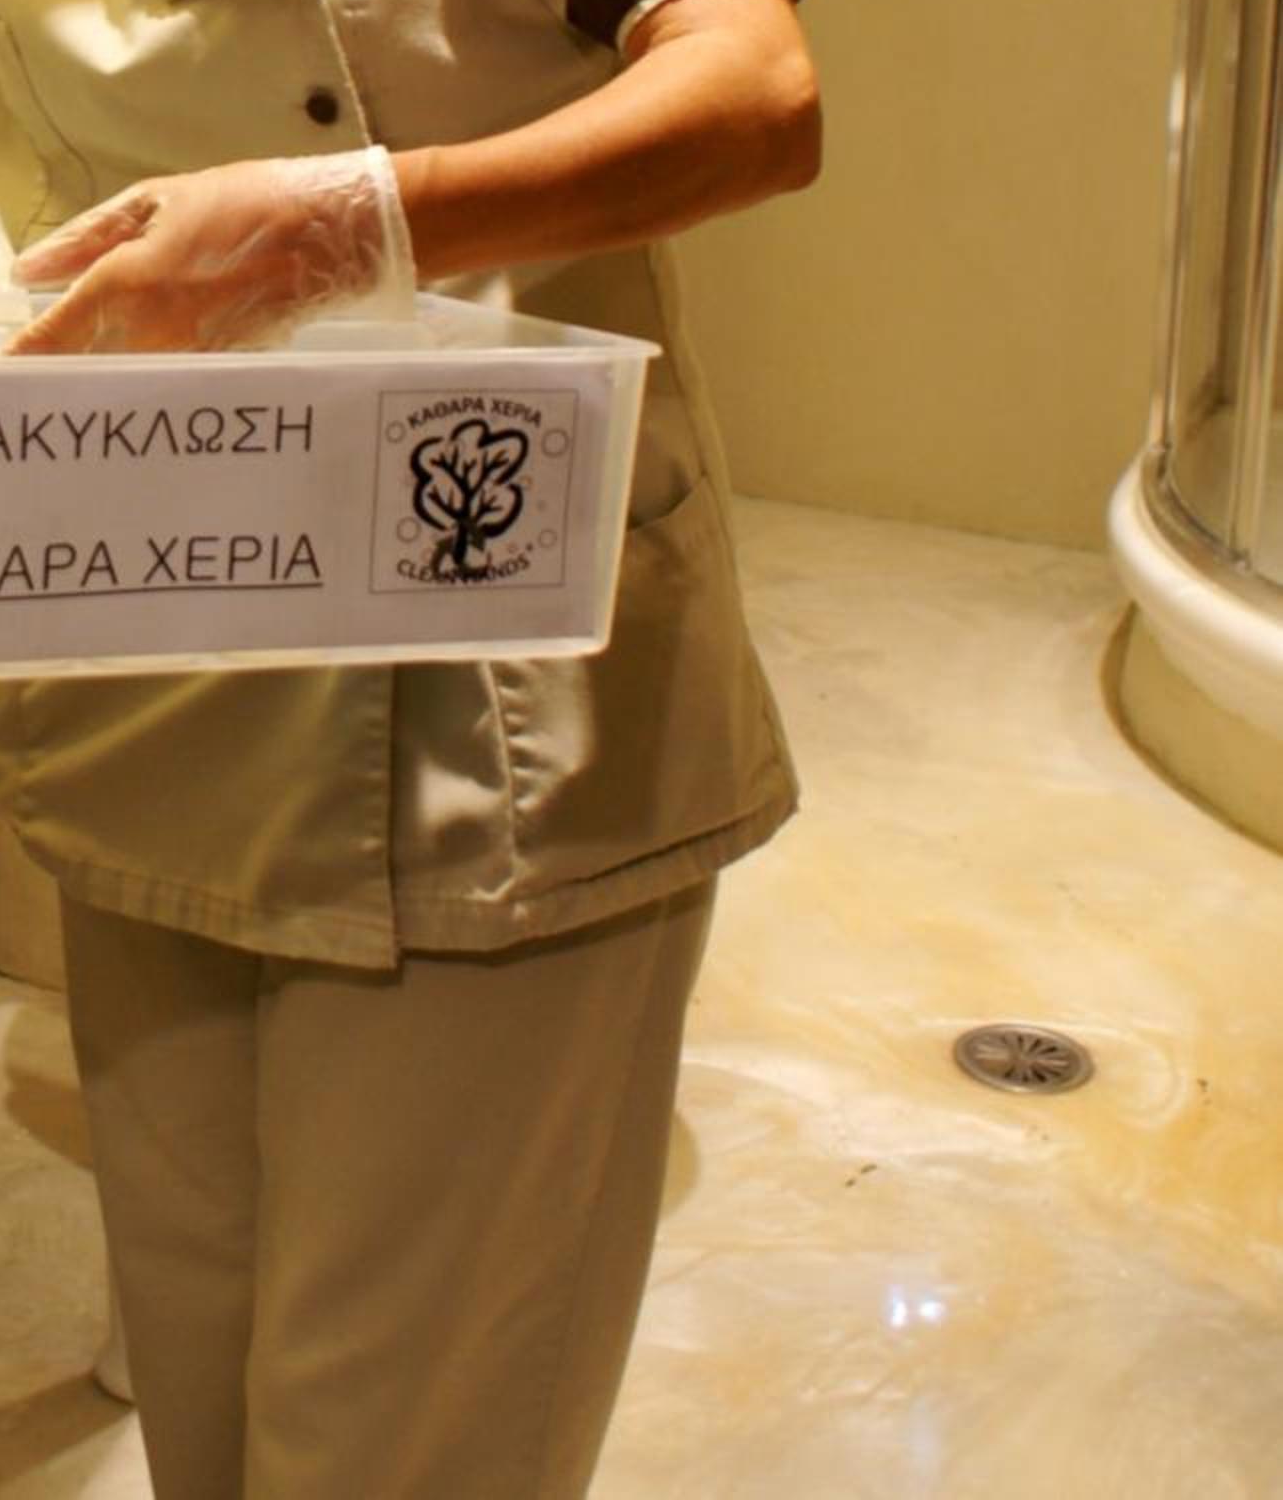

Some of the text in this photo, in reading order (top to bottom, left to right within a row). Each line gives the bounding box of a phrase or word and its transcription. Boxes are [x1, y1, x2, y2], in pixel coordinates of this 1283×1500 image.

[408, 397, 541, 428] ΚΑΘΑΡΑ ΧΕΡΙΑ
[143, 533, 322, 585] ΧΕΡΙΑ
[461, 552, 530, 583] NDS
